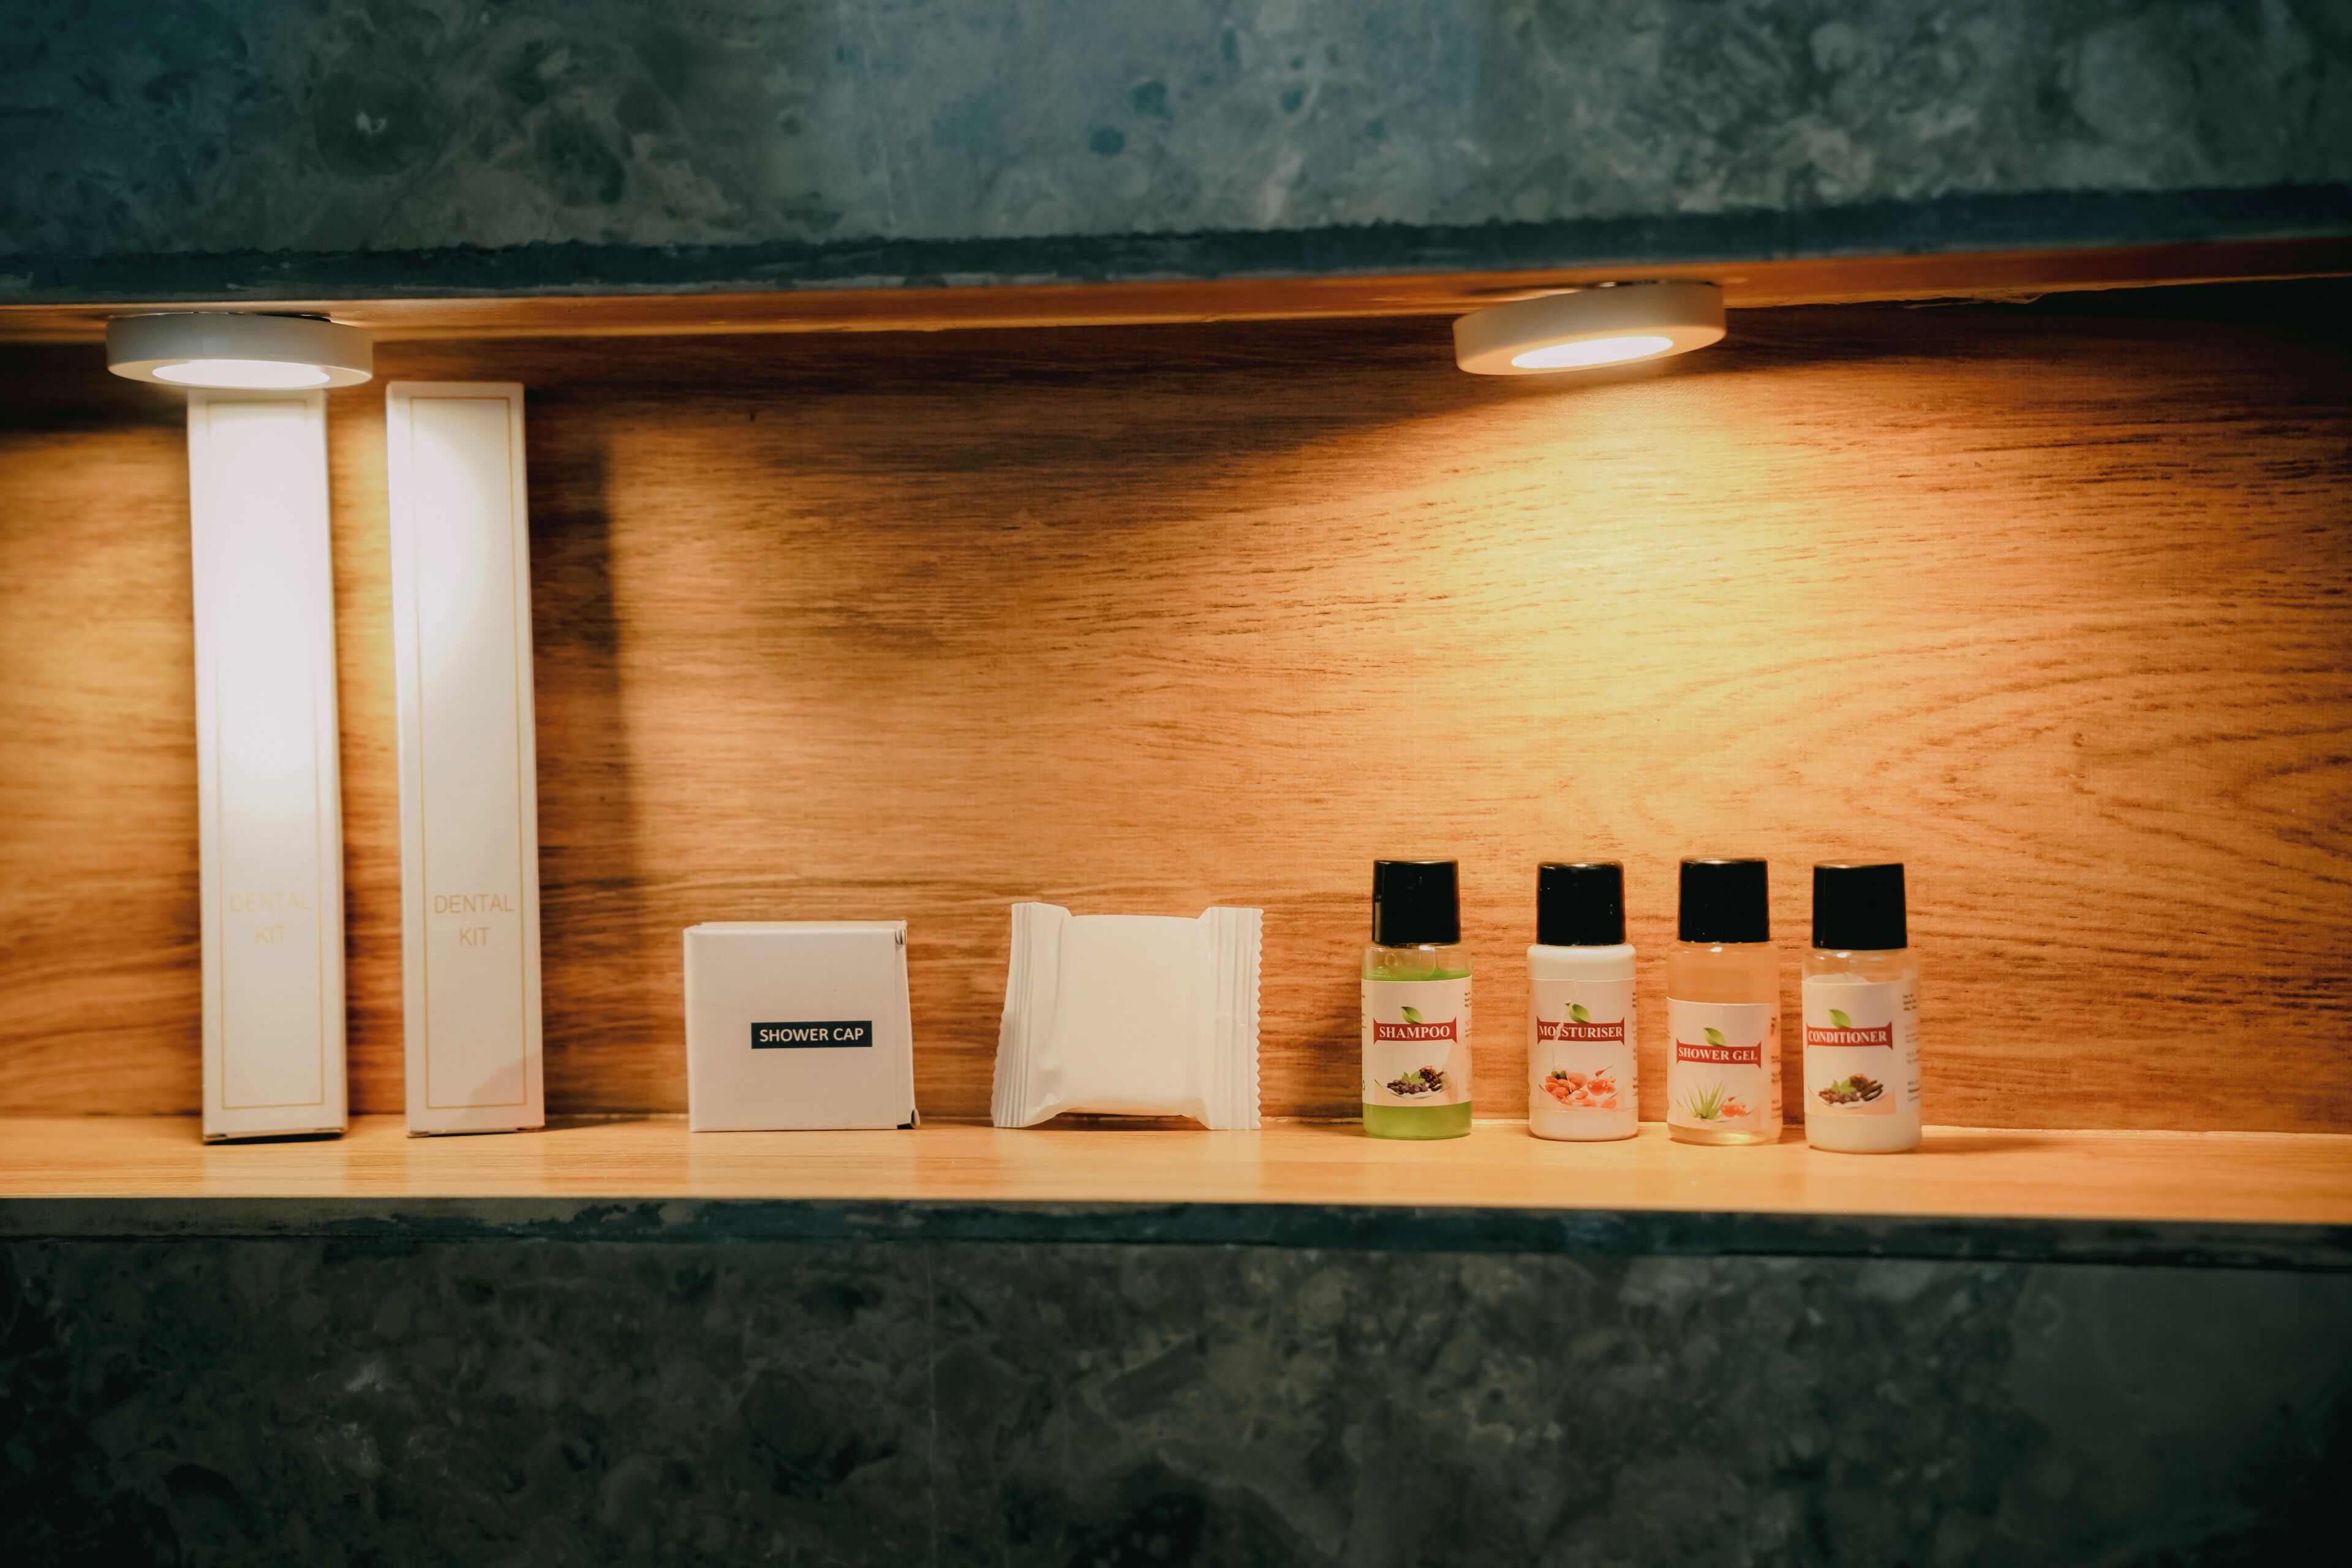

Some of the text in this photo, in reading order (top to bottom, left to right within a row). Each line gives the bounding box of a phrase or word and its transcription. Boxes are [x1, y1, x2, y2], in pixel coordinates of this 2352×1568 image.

[230, 892, 312, 912] DENTAL
[434, 894, 514, 913] DENTAL
[255, 925, 288, 943] KIT
[459, 927, 489, 946] KIT
[760, 1028, 864, 1042] SHOWER CAP
[1379, 1025, 1450, 1039] SHAMPOO
[1807, 1030, 1887, 1042] CONDITIONER
[1678, 1046, 1730, 1060] SHOWER
[1733, 1049, 1758, 1061] GEL
